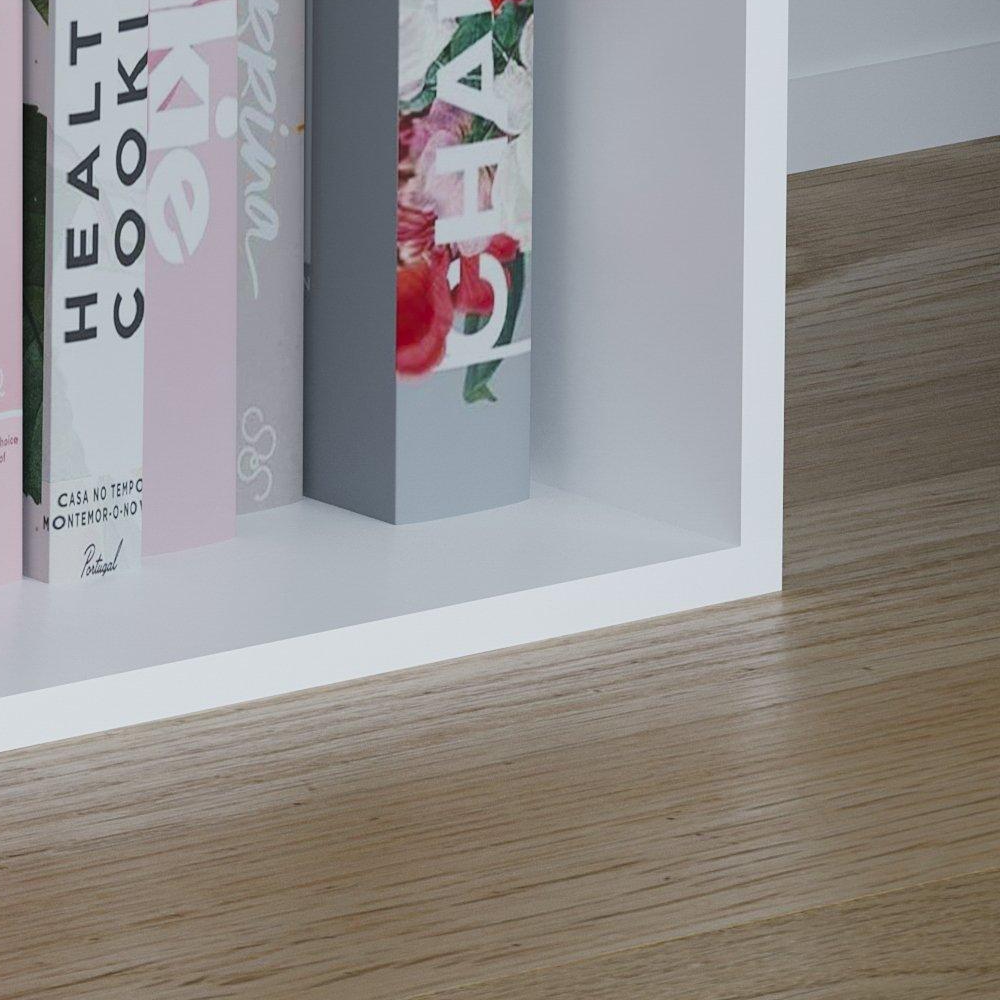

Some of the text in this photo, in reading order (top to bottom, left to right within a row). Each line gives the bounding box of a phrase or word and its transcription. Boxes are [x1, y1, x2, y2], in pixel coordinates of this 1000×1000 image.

[58, 490, 89, 508] CASA
[93, 486, 107, 503] NO
[81, 537, 124, 579] Portugal
